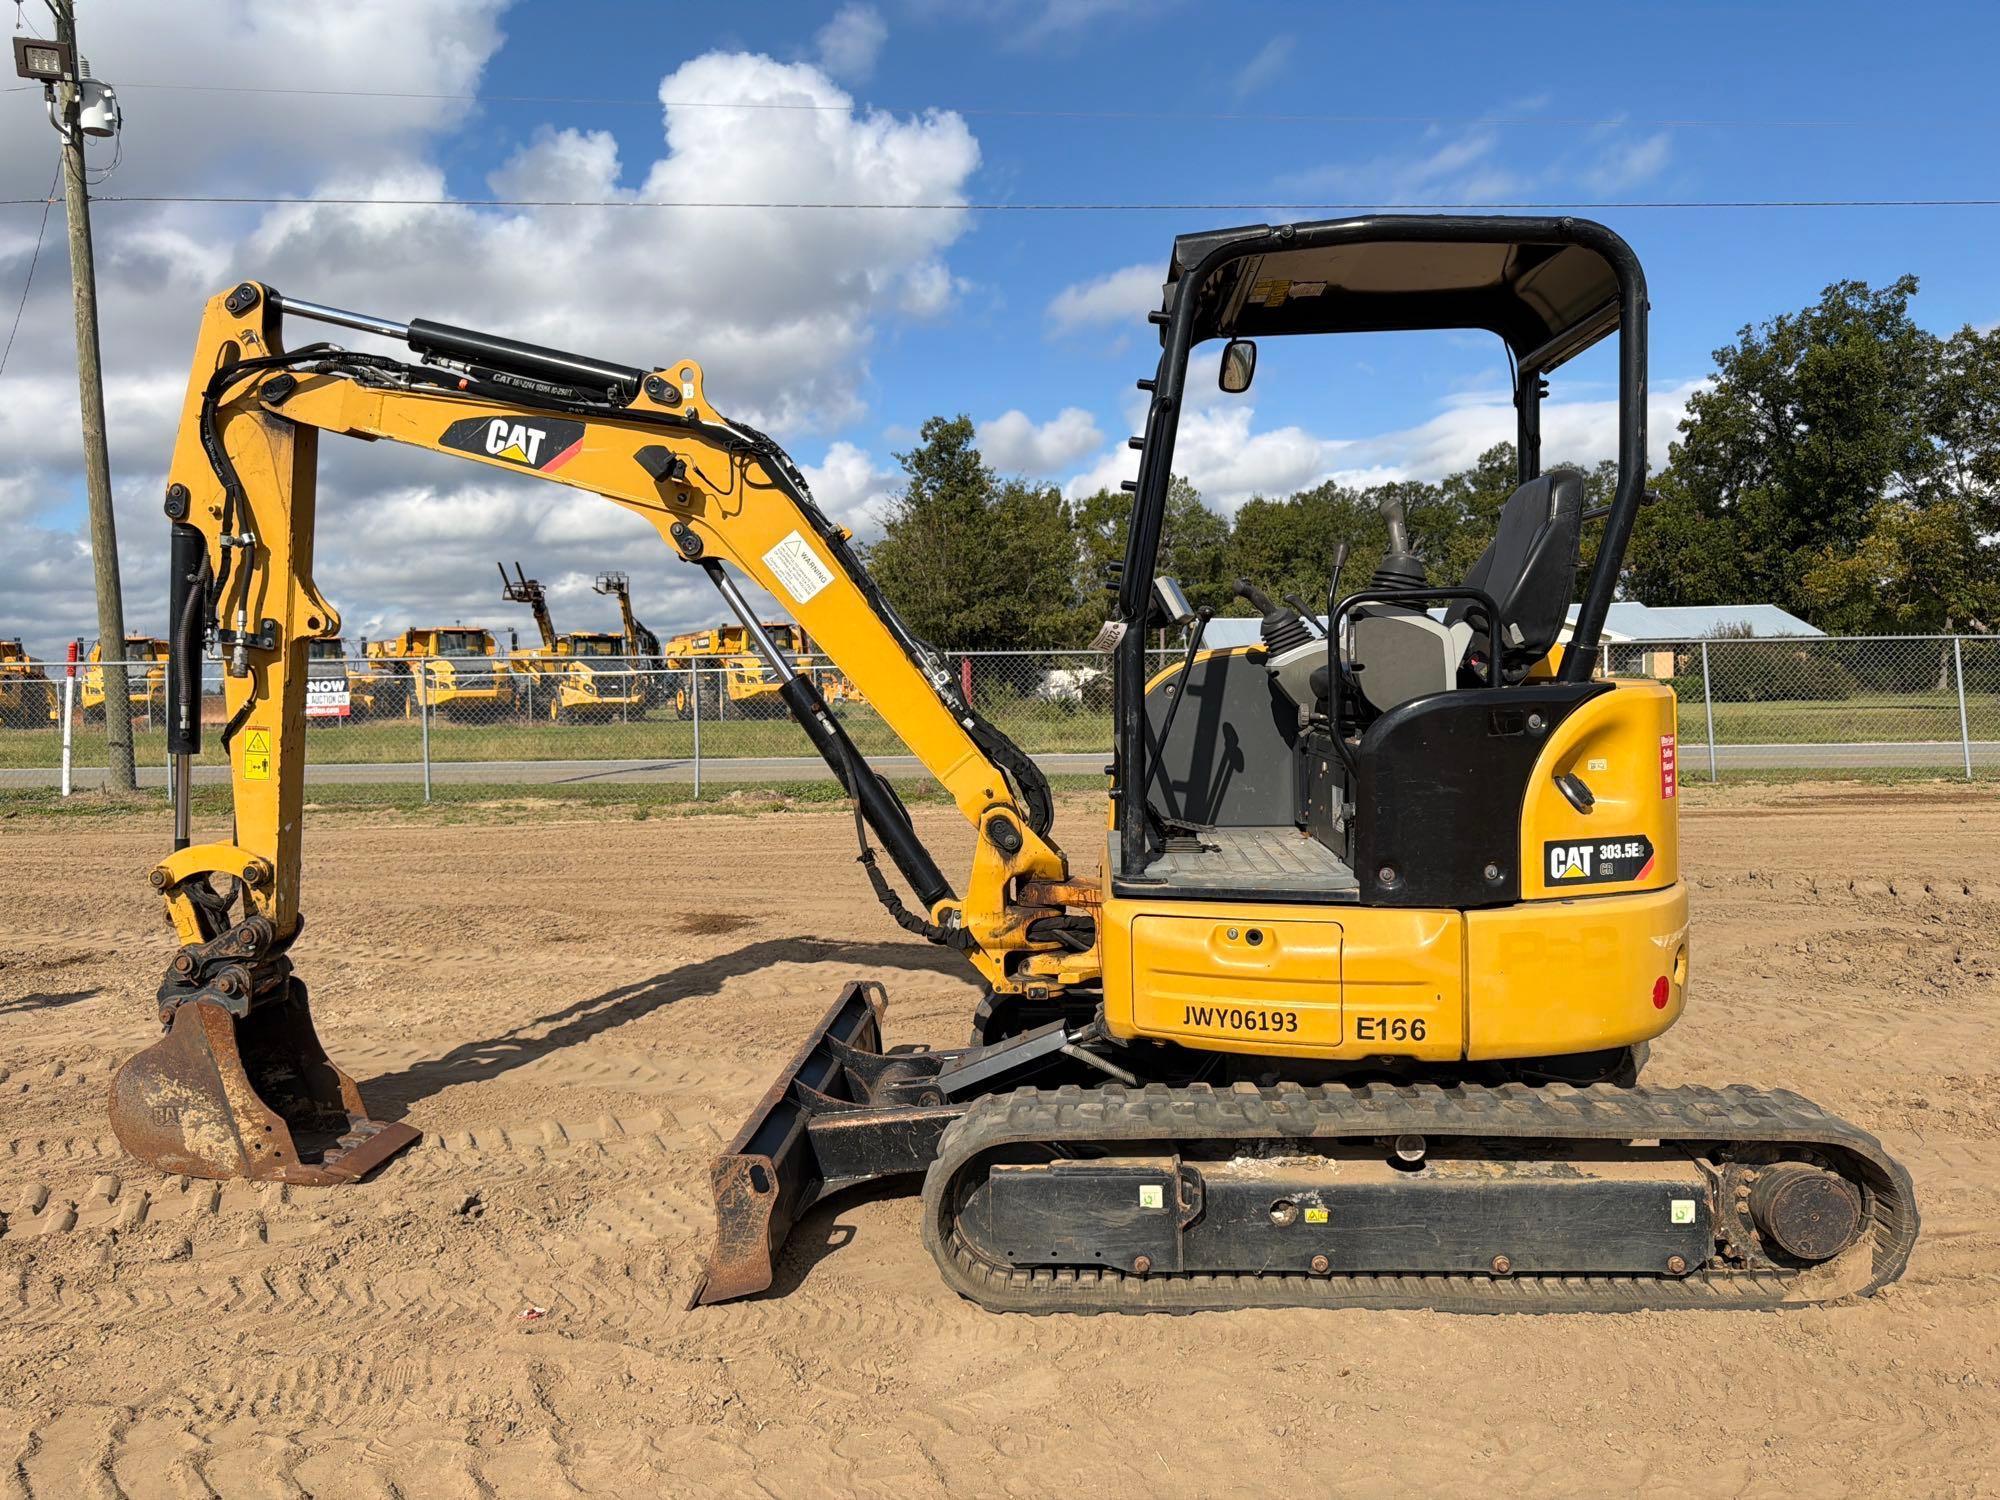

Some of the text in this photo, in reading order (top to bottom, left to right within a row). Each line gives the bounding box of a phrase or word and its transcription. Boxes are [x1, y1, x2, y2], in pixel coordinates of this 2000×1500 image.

[493, 373, 513, 385] CAT
[485, 419, 546, 465] CAT
[801, 551, 827, 584] WARNING
[307, 680, 345, 692] NOW
[312, 695, 336, 704] AUCTION
[305, 707, 339, 715] uction.com
[1551, 842, 1645, 879] CAT 303.5E2
[1600, 862, 1613, 875] CR
[1183, 1006, 1426, 1041] JWY06193 E166
